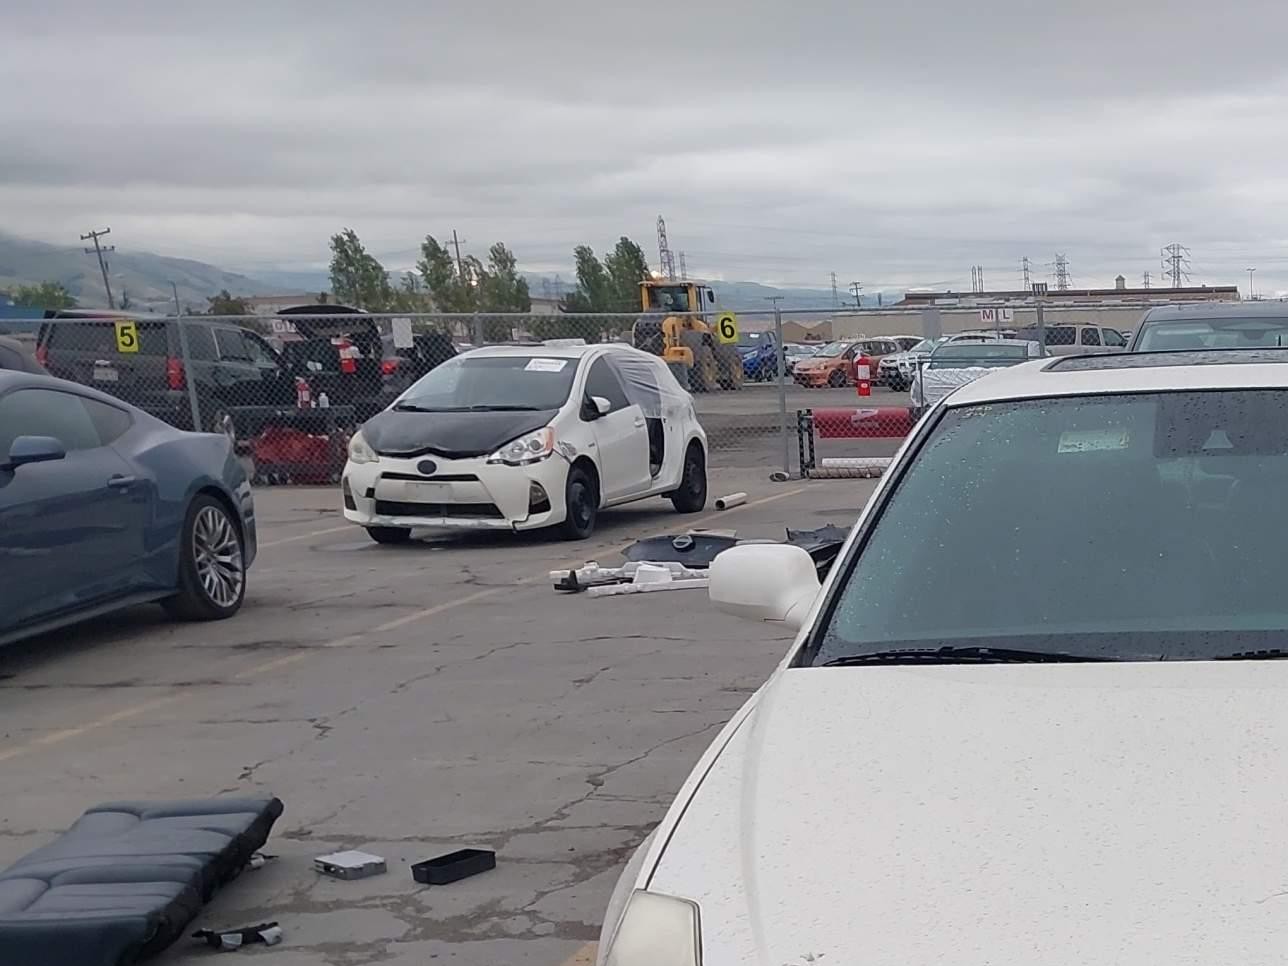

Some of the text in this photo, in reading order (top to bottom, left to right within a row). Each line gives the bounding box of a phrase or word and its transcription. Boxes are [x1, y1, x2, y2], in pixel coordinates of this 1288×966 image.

[983, 310, 993, 320] M
[1003, 310, 1010, 319] L
[720, 317, 735, 339] 6
[120, 326, 135, 348] 5
